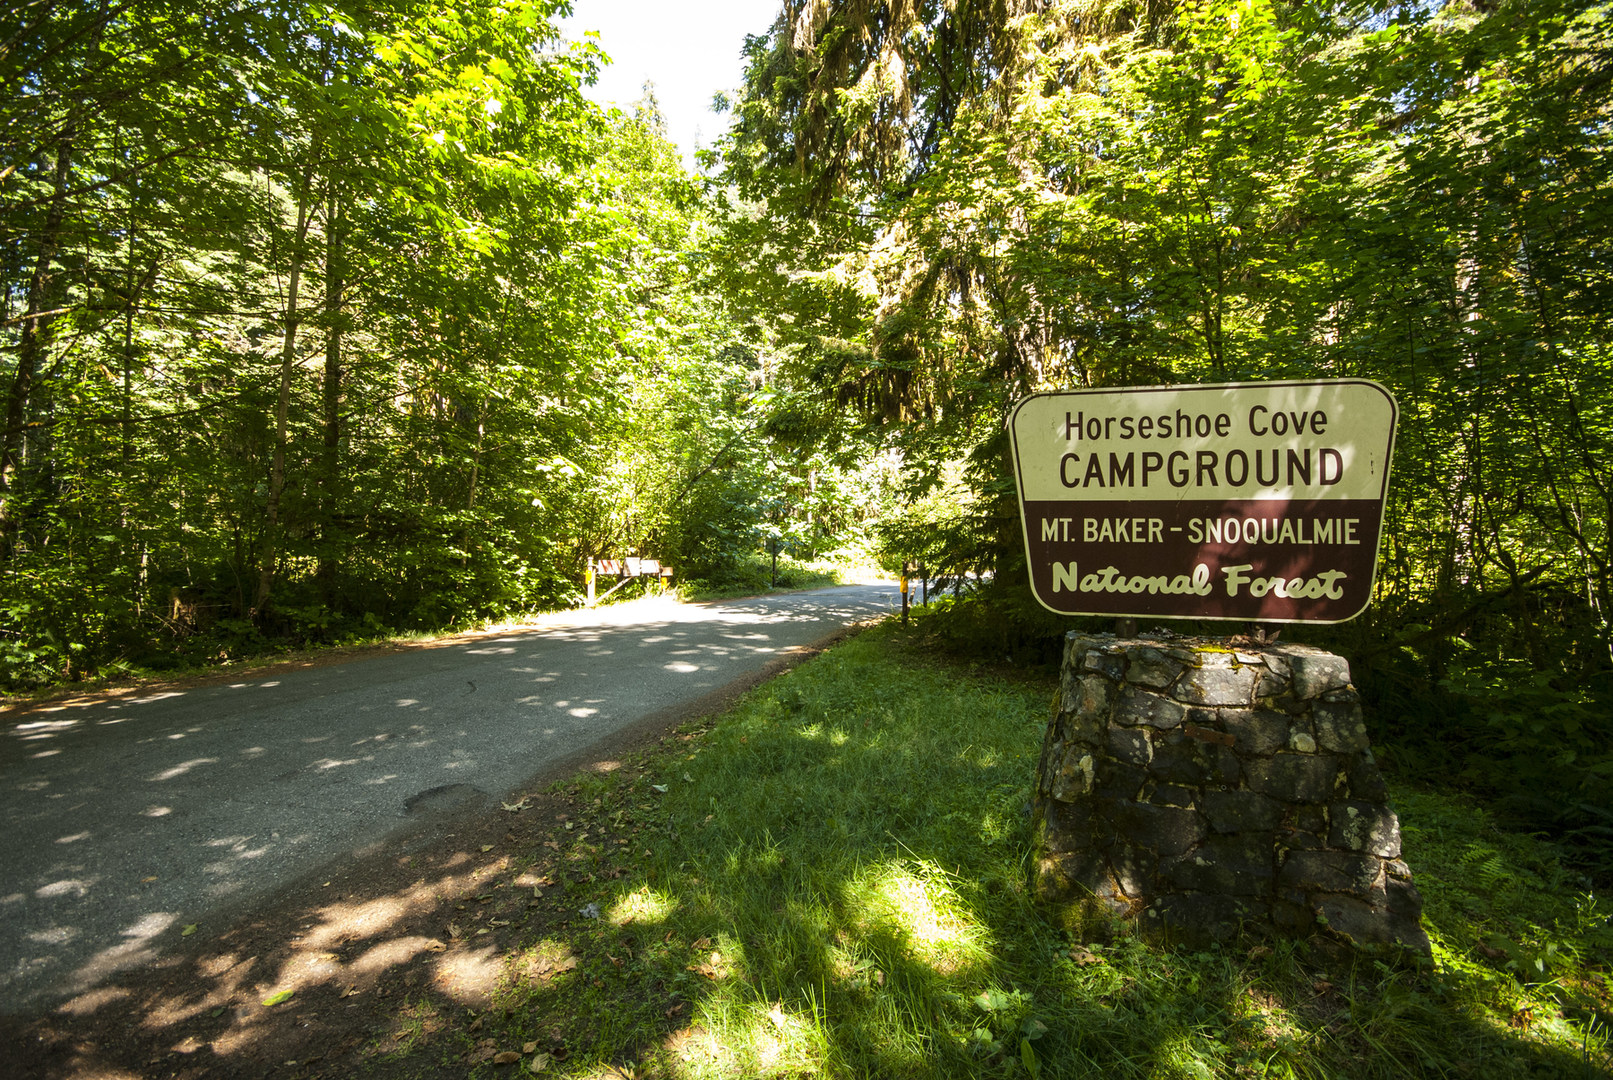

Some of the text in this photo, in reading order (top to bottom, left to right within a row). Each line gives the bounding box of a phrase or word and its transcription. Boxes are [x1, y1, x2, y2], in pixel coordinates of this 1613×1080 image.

[1065, 405, 1328, 440] Horseshoe Cove
[1059, 448, 1344, 489] CAMPGROUND
[1041, 518, 1075, 543] MT.
[1083, 518, 1164, 543] BAKER
[1188, 517, 1361, 545] SNOQUALMIE
[1052, 561, 1348, 600] National Forest
